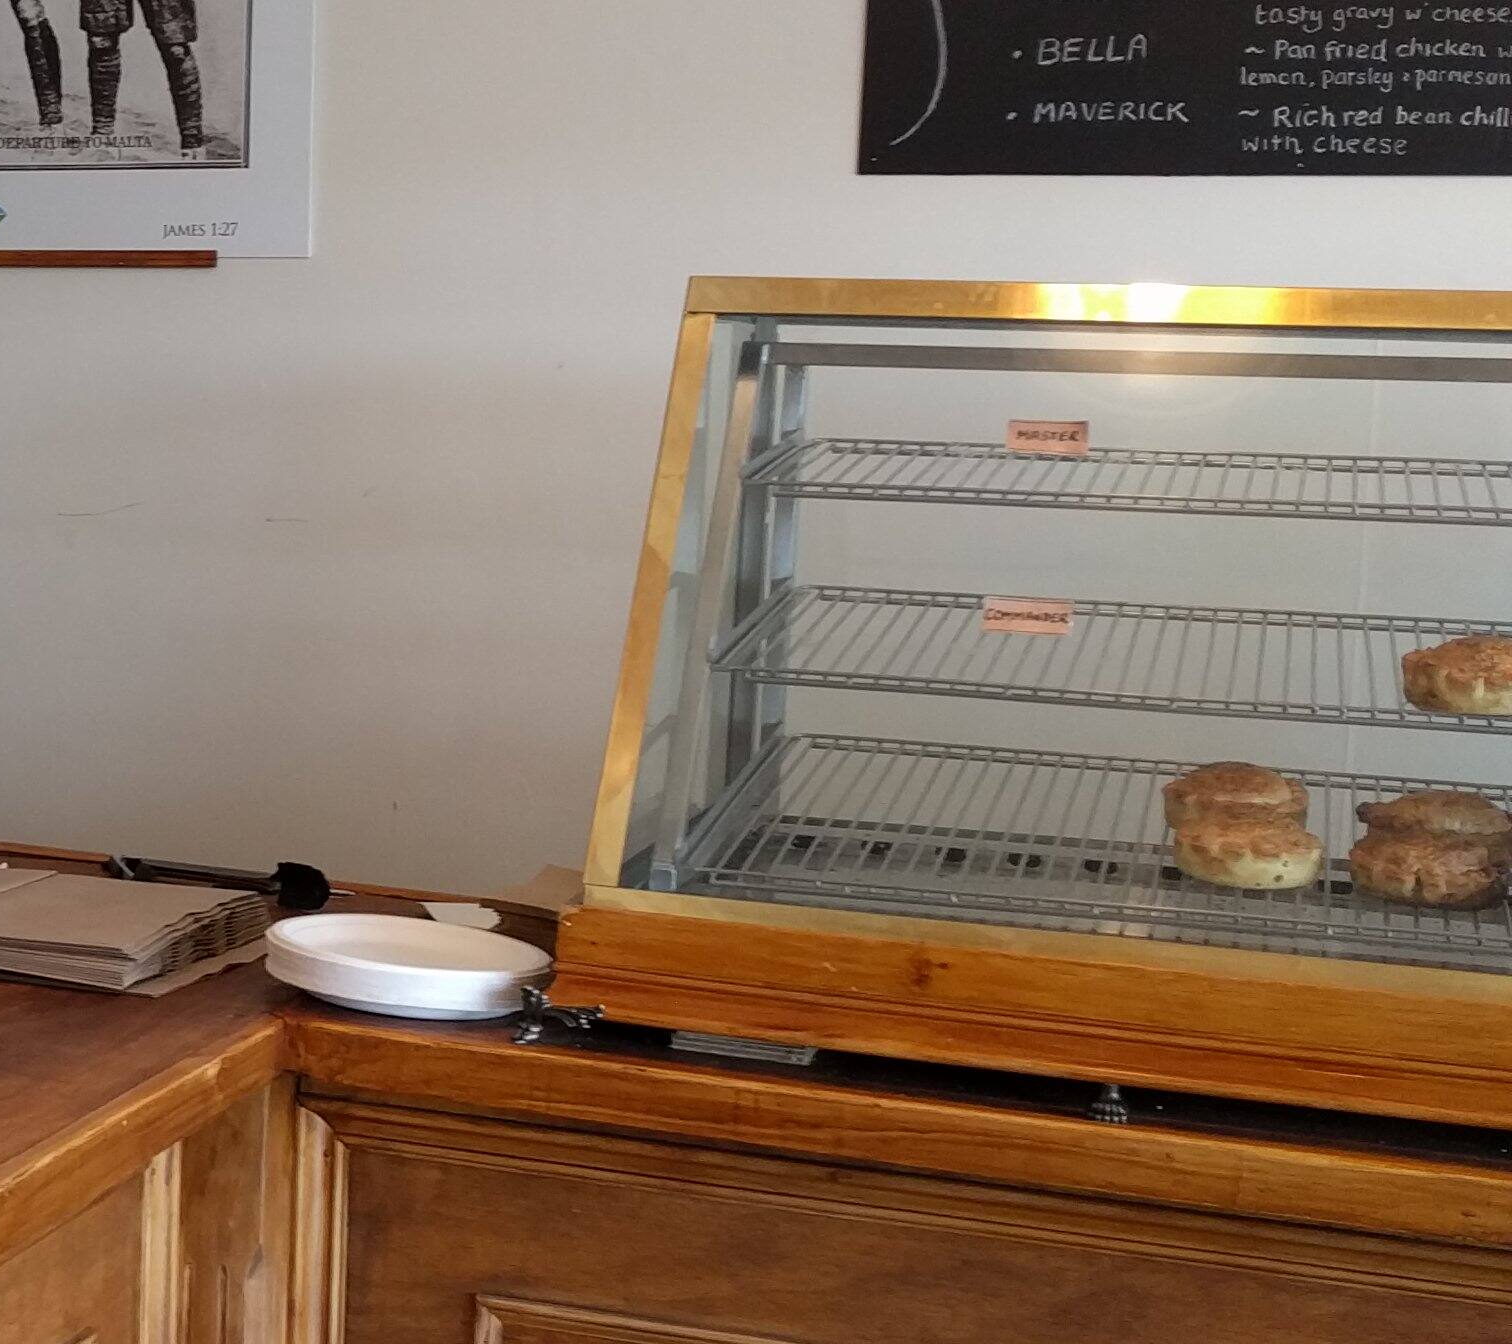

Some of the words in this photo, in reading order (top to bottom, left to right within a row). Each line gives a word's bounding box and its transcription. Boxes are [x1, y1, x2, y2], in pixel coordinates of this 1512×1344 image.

[1254, 4, 1323, 34] tasty
[1333, 7, 1394, 32] gravy
[1036, 34, 1148, 66] BELLA
[1274, 39, 1316, 60] Pan
[1325, 39, 1388, 62] fried
[1396, 37, 1487, 57] chicken
[1321, 68, 1394, 93] parsley
[1033, 99, 1189, 126] MAVERICK
[1273, 104, 1337, 128] Rich
[1342, 106, 1384, 127] red
[1394, 106, 1452, 125] bean
[1241, 135, 1304, 154] with
[1313, 135, 1408, 156] cheese
[163, 224, 206, 239] JAMES
[1016, 429, 1080, 443] MASTER
